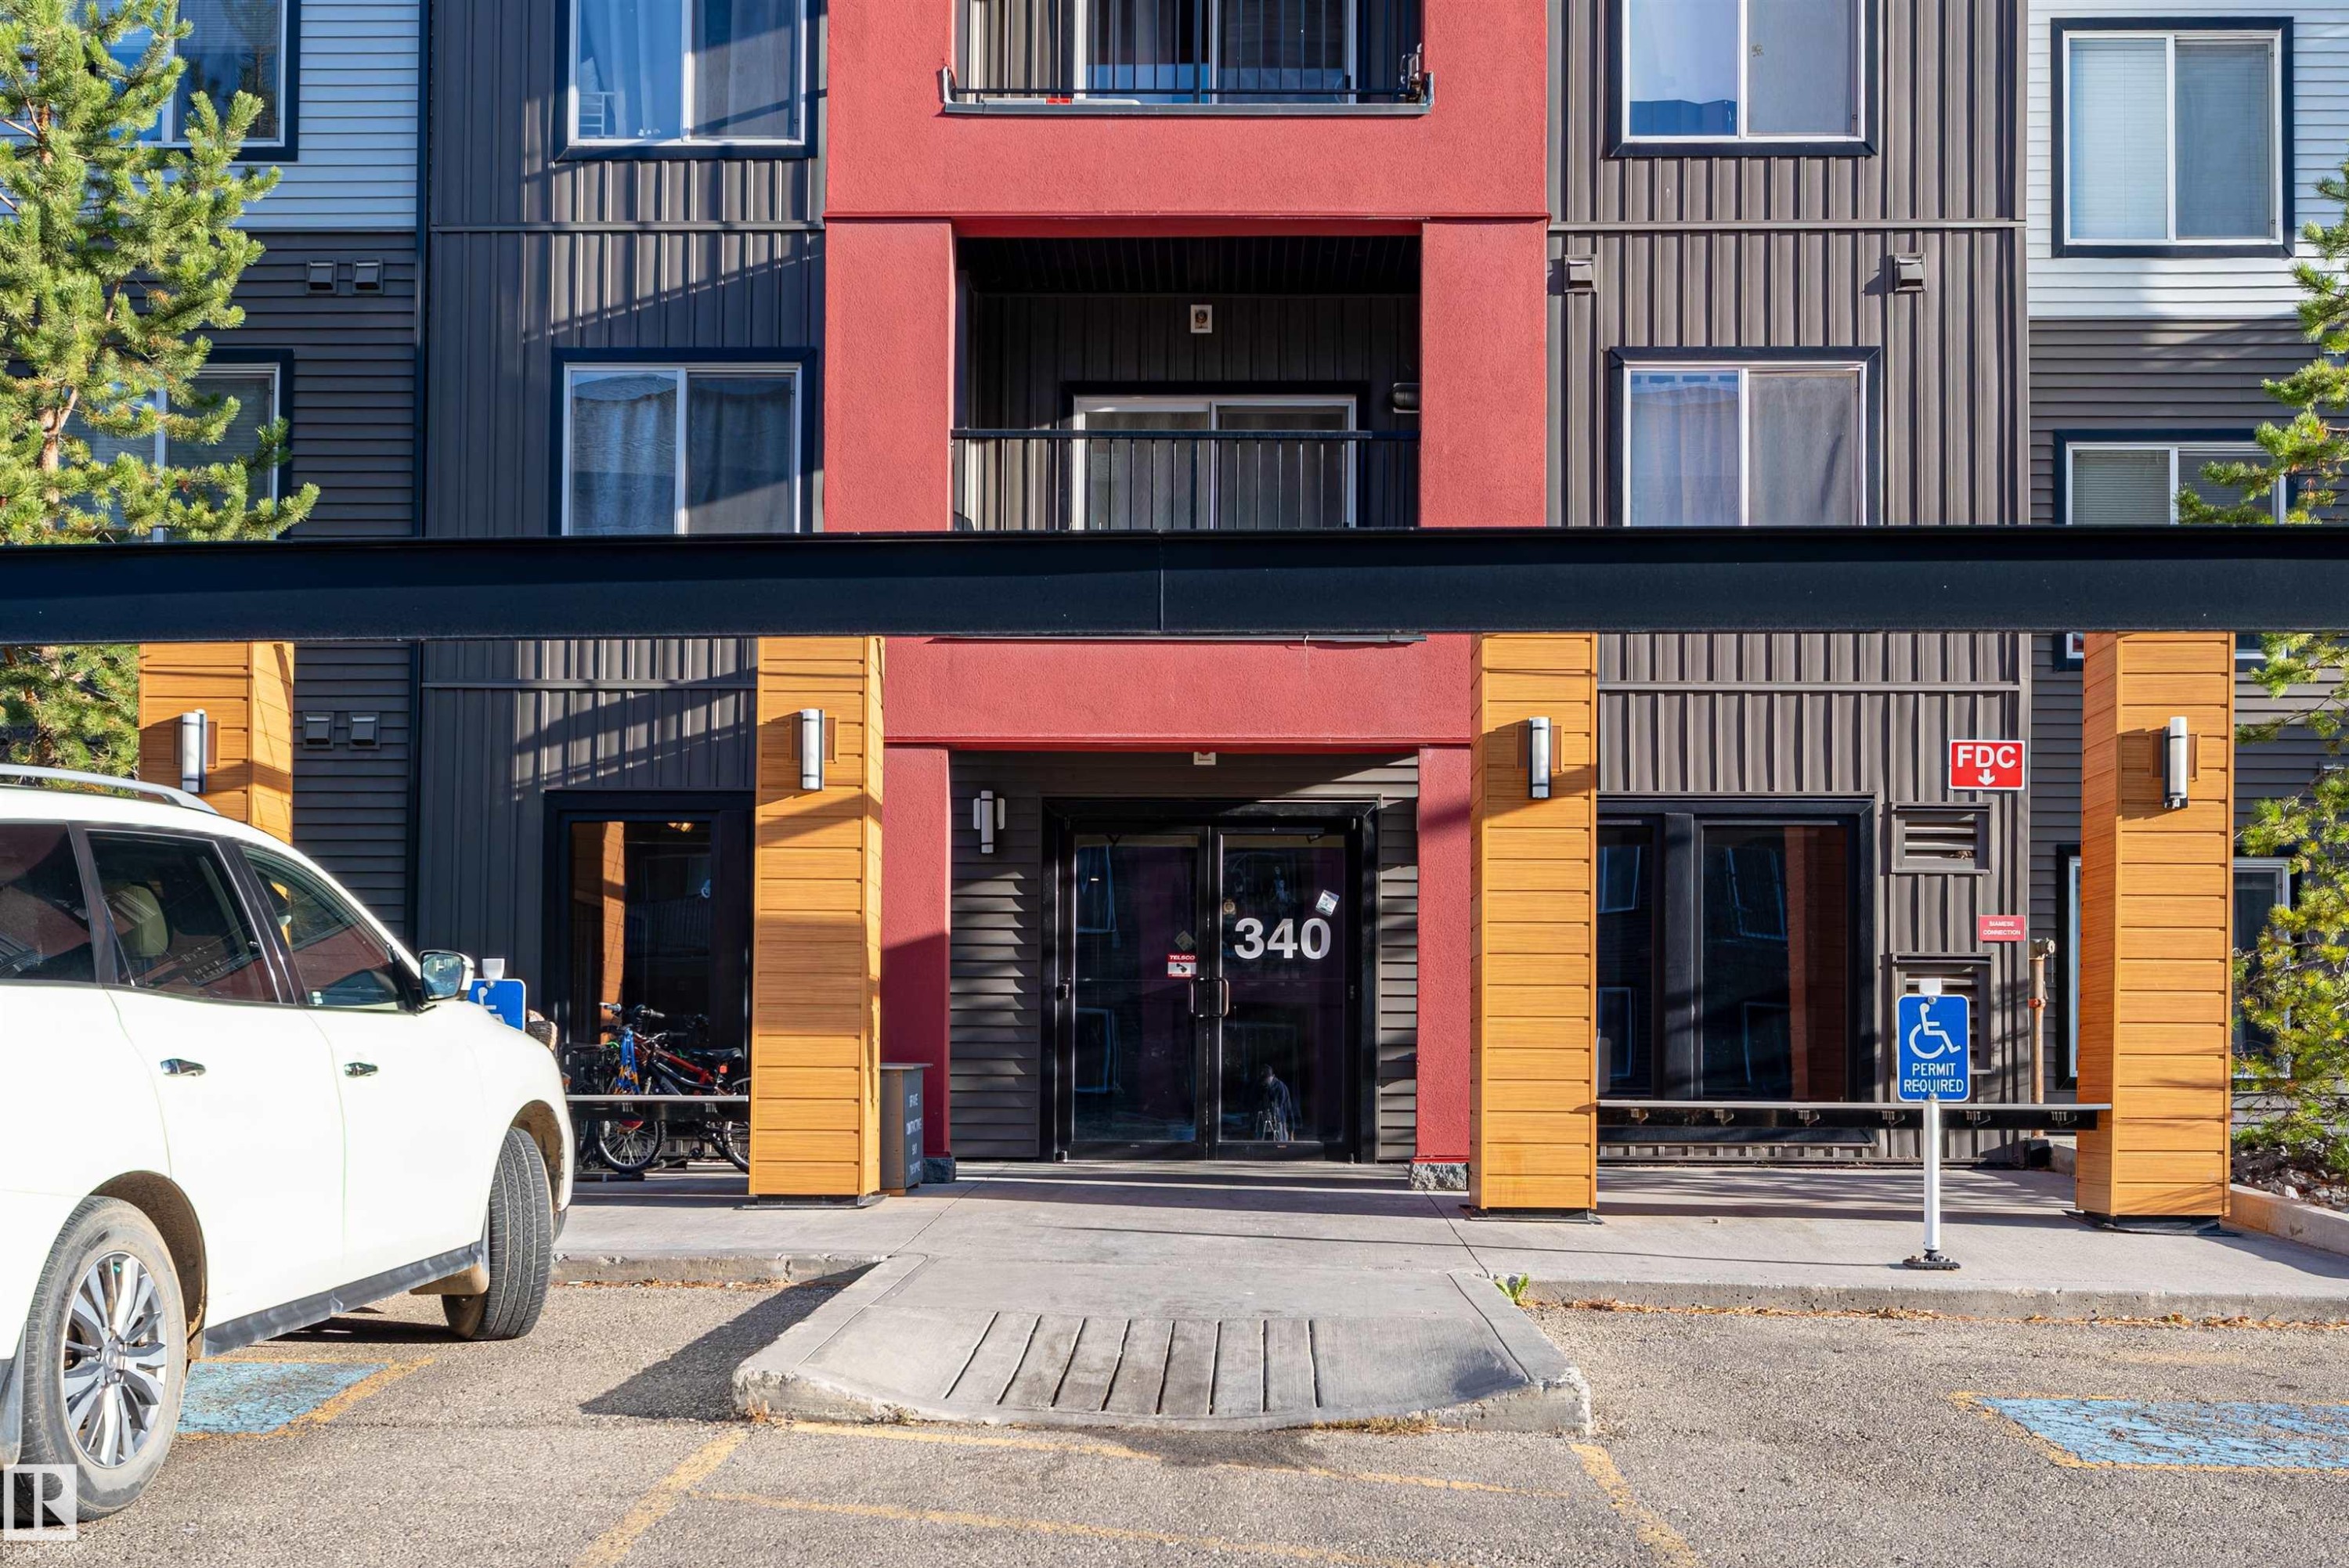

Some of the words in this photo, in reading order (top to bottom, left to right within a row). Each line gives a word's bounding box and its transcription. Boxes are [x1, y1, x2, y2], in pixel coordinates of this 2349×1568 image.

[1957, 744, 2017, 769] FDC
[1234, 917, 1332, 960] 340
[1912, 1062, 1956, 1076] PERMIT
[1903, 1079, 1964, 1093] REQUIRED
